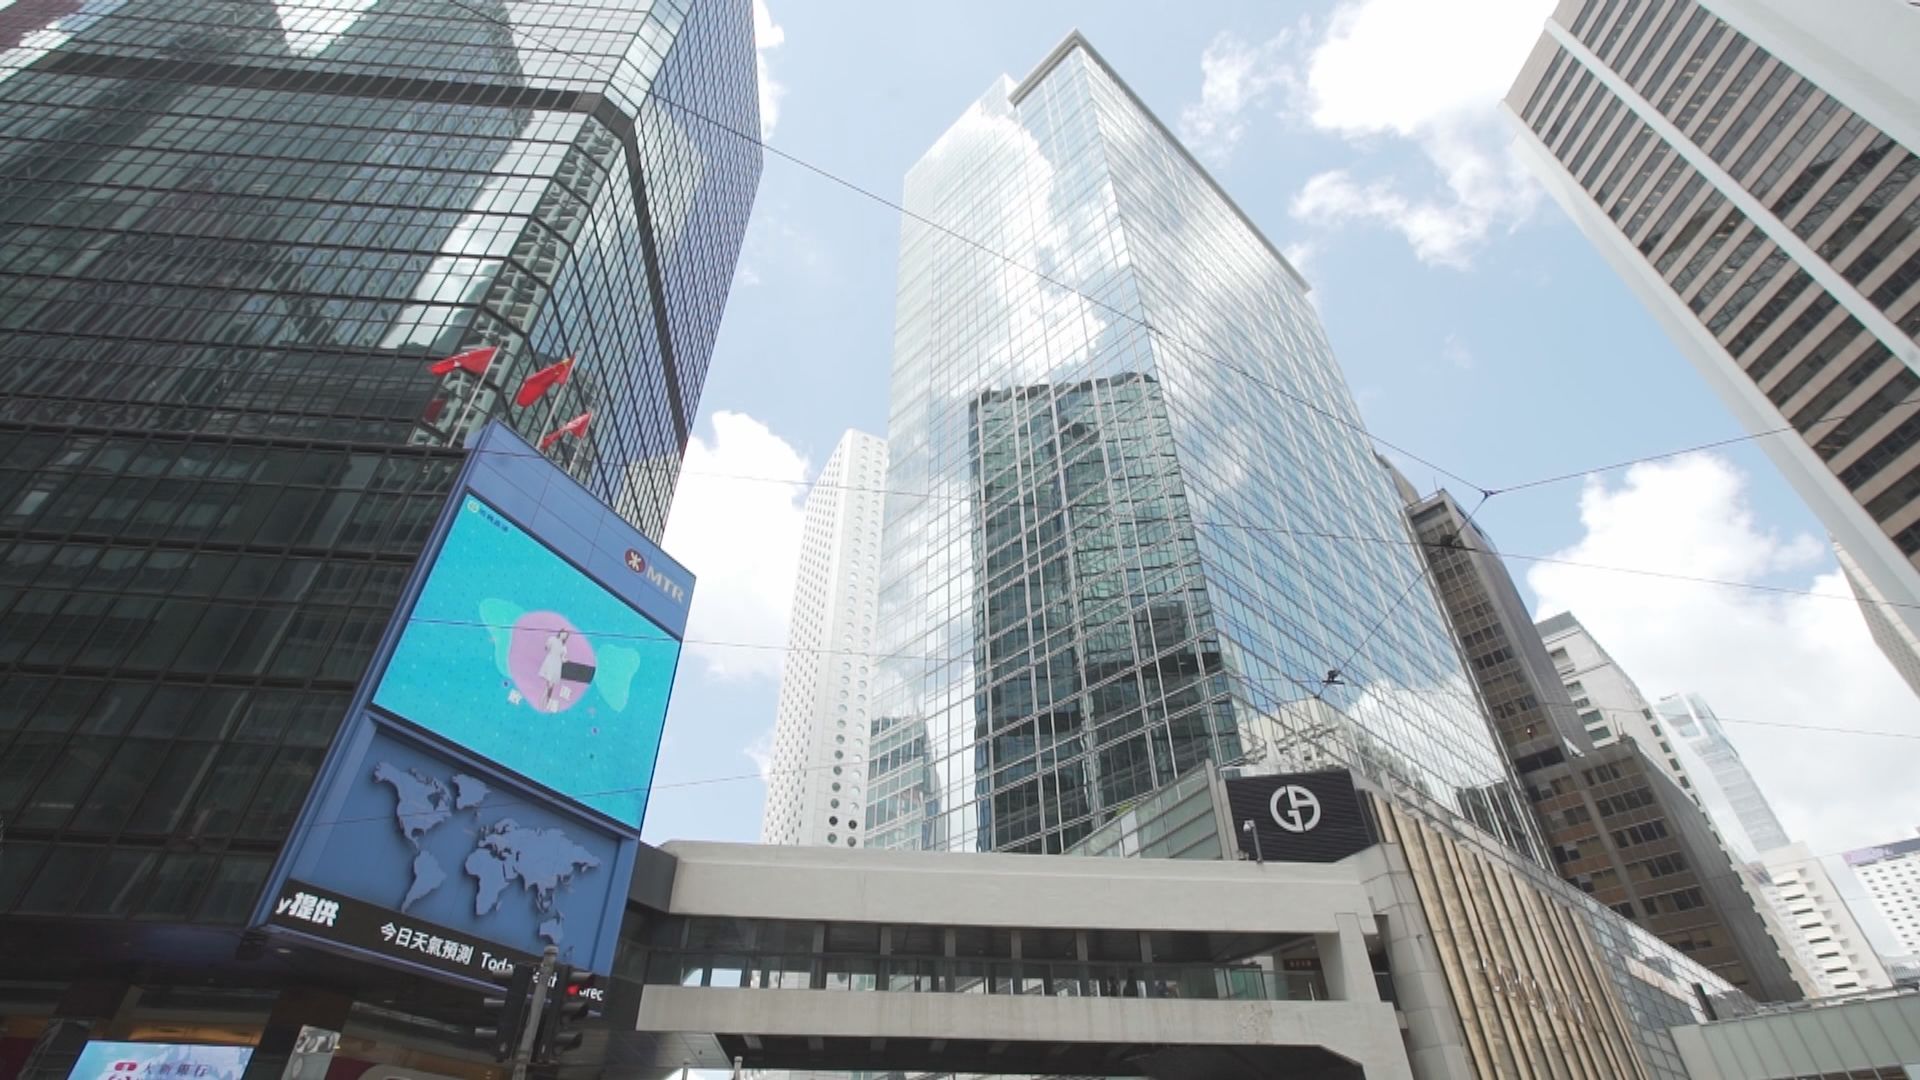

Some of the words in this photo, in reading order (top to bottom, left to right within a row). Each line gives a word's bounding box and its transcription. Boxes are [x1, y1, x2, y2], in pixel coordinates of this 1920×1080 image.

[646, 565, 684, 604] MTR
[381, 922, 474, 965] 今日天氣預測
